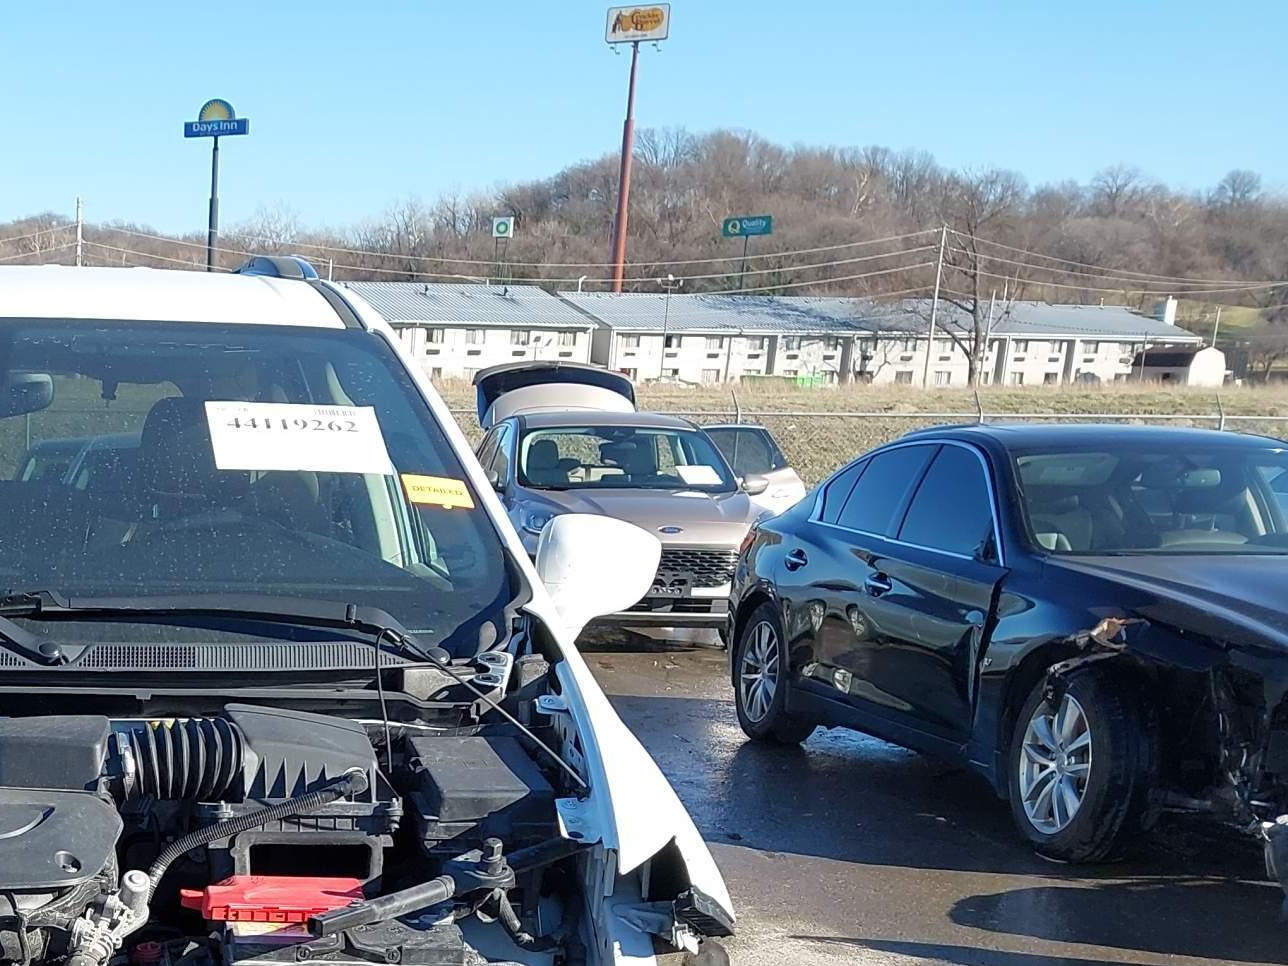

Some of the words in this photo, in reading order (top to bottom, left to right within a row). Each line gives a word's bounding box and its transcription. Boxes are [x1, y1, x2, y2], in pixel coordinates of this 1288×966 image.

[192, 122, 218, 133] Days
[220, 121, 238, 131] Inn
[226, 412, 359, 433] 44119262
